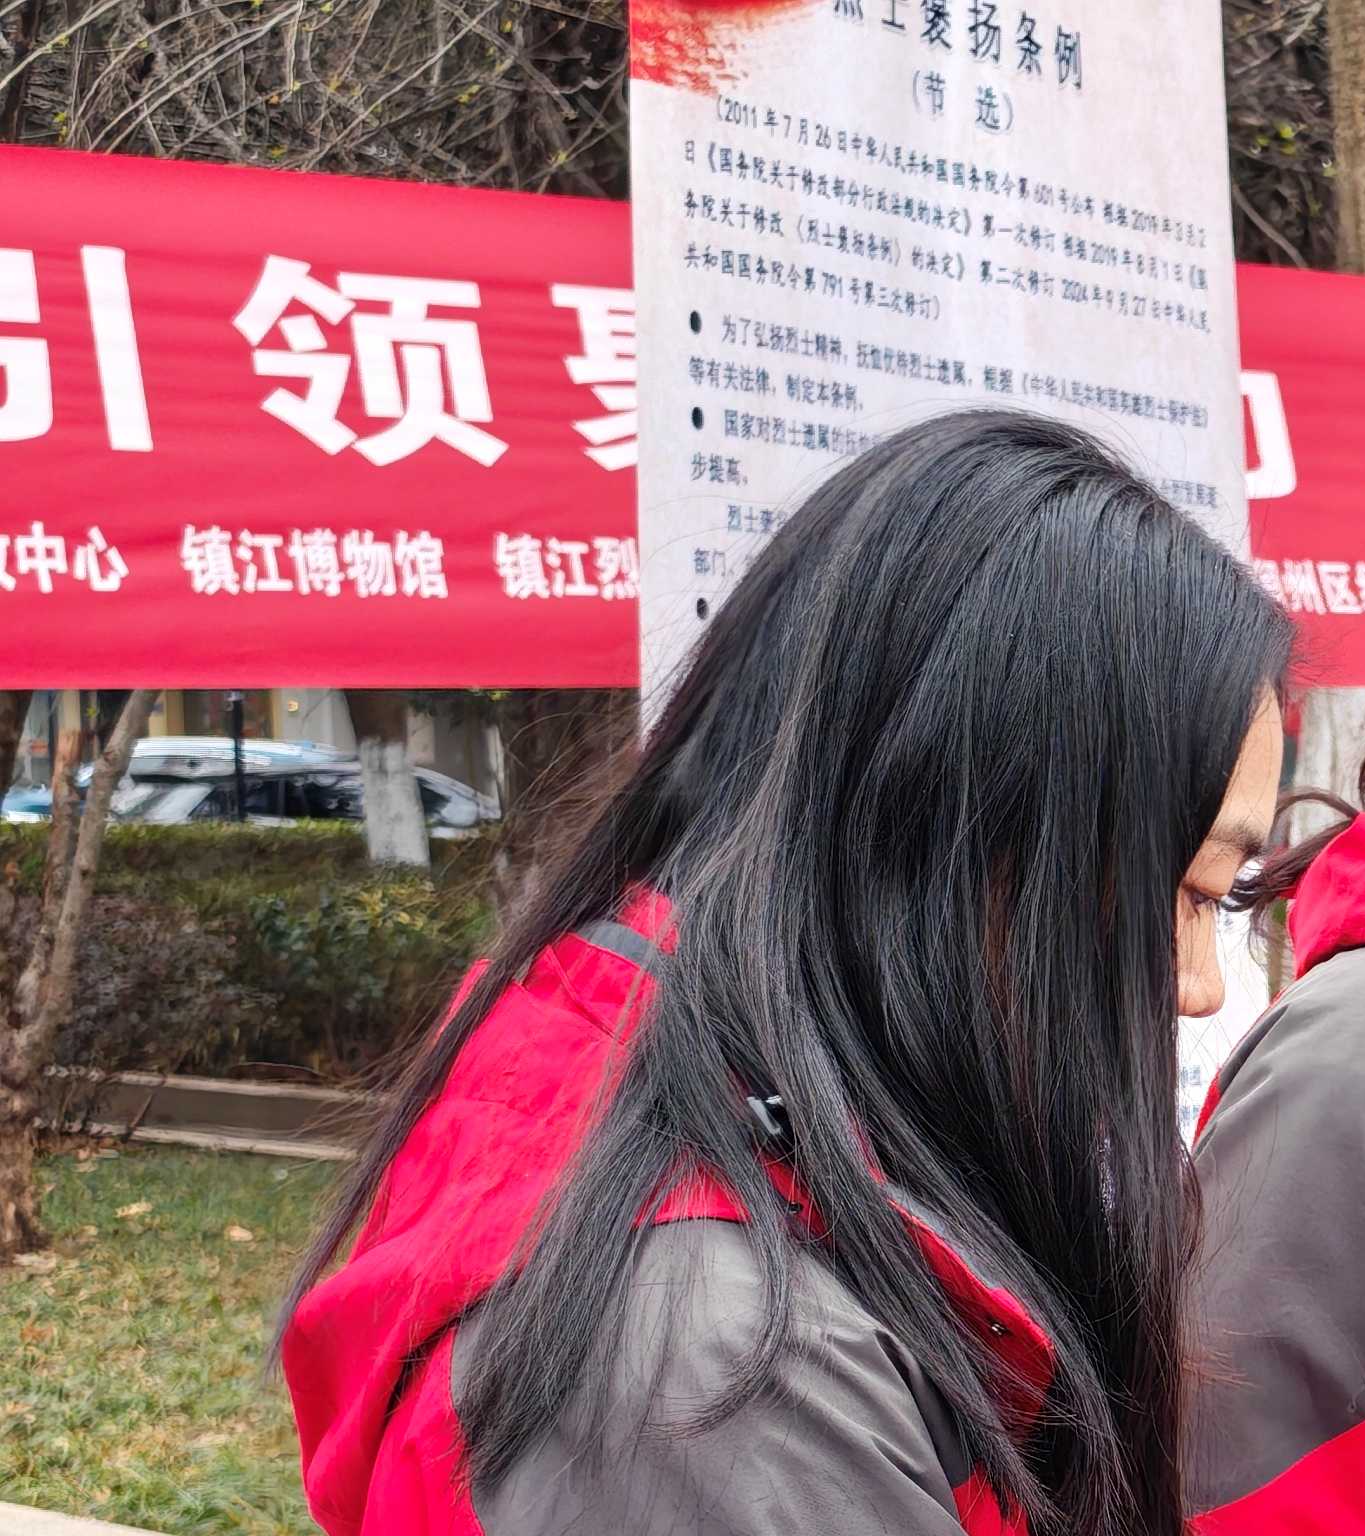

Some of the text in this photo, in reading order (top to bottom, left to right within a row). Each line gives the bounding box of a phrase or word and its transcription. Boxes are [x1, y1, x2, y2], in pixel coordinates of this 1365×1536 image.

[180, 523, 449, 599] 镇江博物馆
